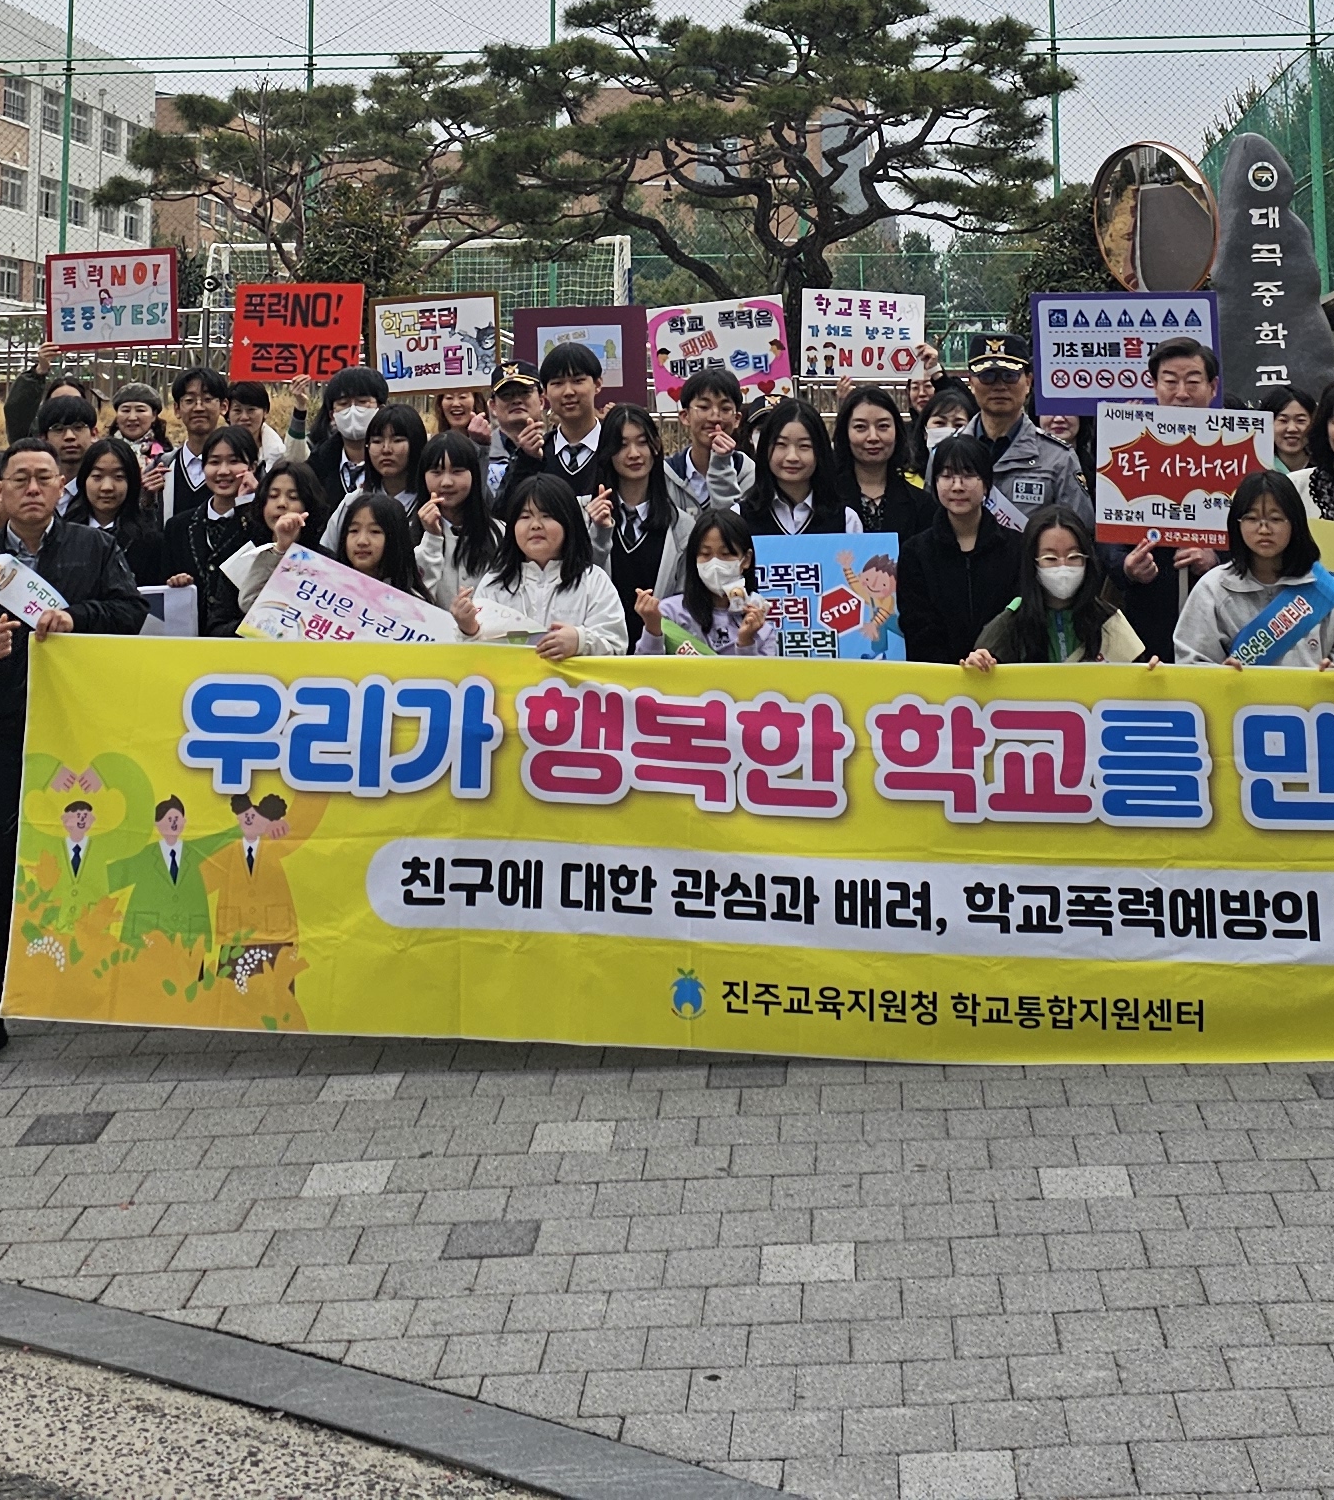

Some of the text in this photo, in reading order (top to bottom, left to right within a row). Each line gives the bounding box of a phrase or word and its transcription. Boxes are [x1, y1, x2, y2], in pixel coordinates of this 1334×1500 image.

[62, 261, 161, 288] 폭력 NO!
[1249, 206, 1291, 386] 대곡중학교
[60, 302, 168, 332] 존중 YES!
[380, 307, 458, 339] 학교폭력
[668, 308, 773, 335] 학교 폭력은
[406, 335, 442, 353] OUT
[679, 330, 718, 357] 패배
[1052, 342, 1078, 358] 기초
[1081, 342, 1121, 358] 질서를
[1123, 337, 1144, 358] 잘
[729, 349, 771, 373] 승리
[1105, 409, 1265, 434] 사이버폭력 신체폭력
[1157, 423, 1197, 436] 언어폭력
[1118, 451, 1150, 482] 모두
[1016, 494, 1041, 502] POLICE
[1103, 508, 1144, 522] 금품갈취
[1151, 502, 1196, 521] 따돌림
[1164, 531, 1227, 544] 진주교육지원청
[295, 579, 354, 618] 당신은
[822, 598, 859, 623] STOP
[185, 681, 495, 793] 우리가
[525, 687, 848, 811] 행복한
[874, 701, 1204, 819] 학교를
[400, 855, 543, 909] 친구에
[559, 862, 658, 916] 대한
[670, 867, 821, 926] 관심과
[833, 877, 949, 936] 배려,
[963, 881, 1322, 942] 학교폭력예방의
[721, 979, 1205, 1033] 진주교육지원청 학교통합지원센터
